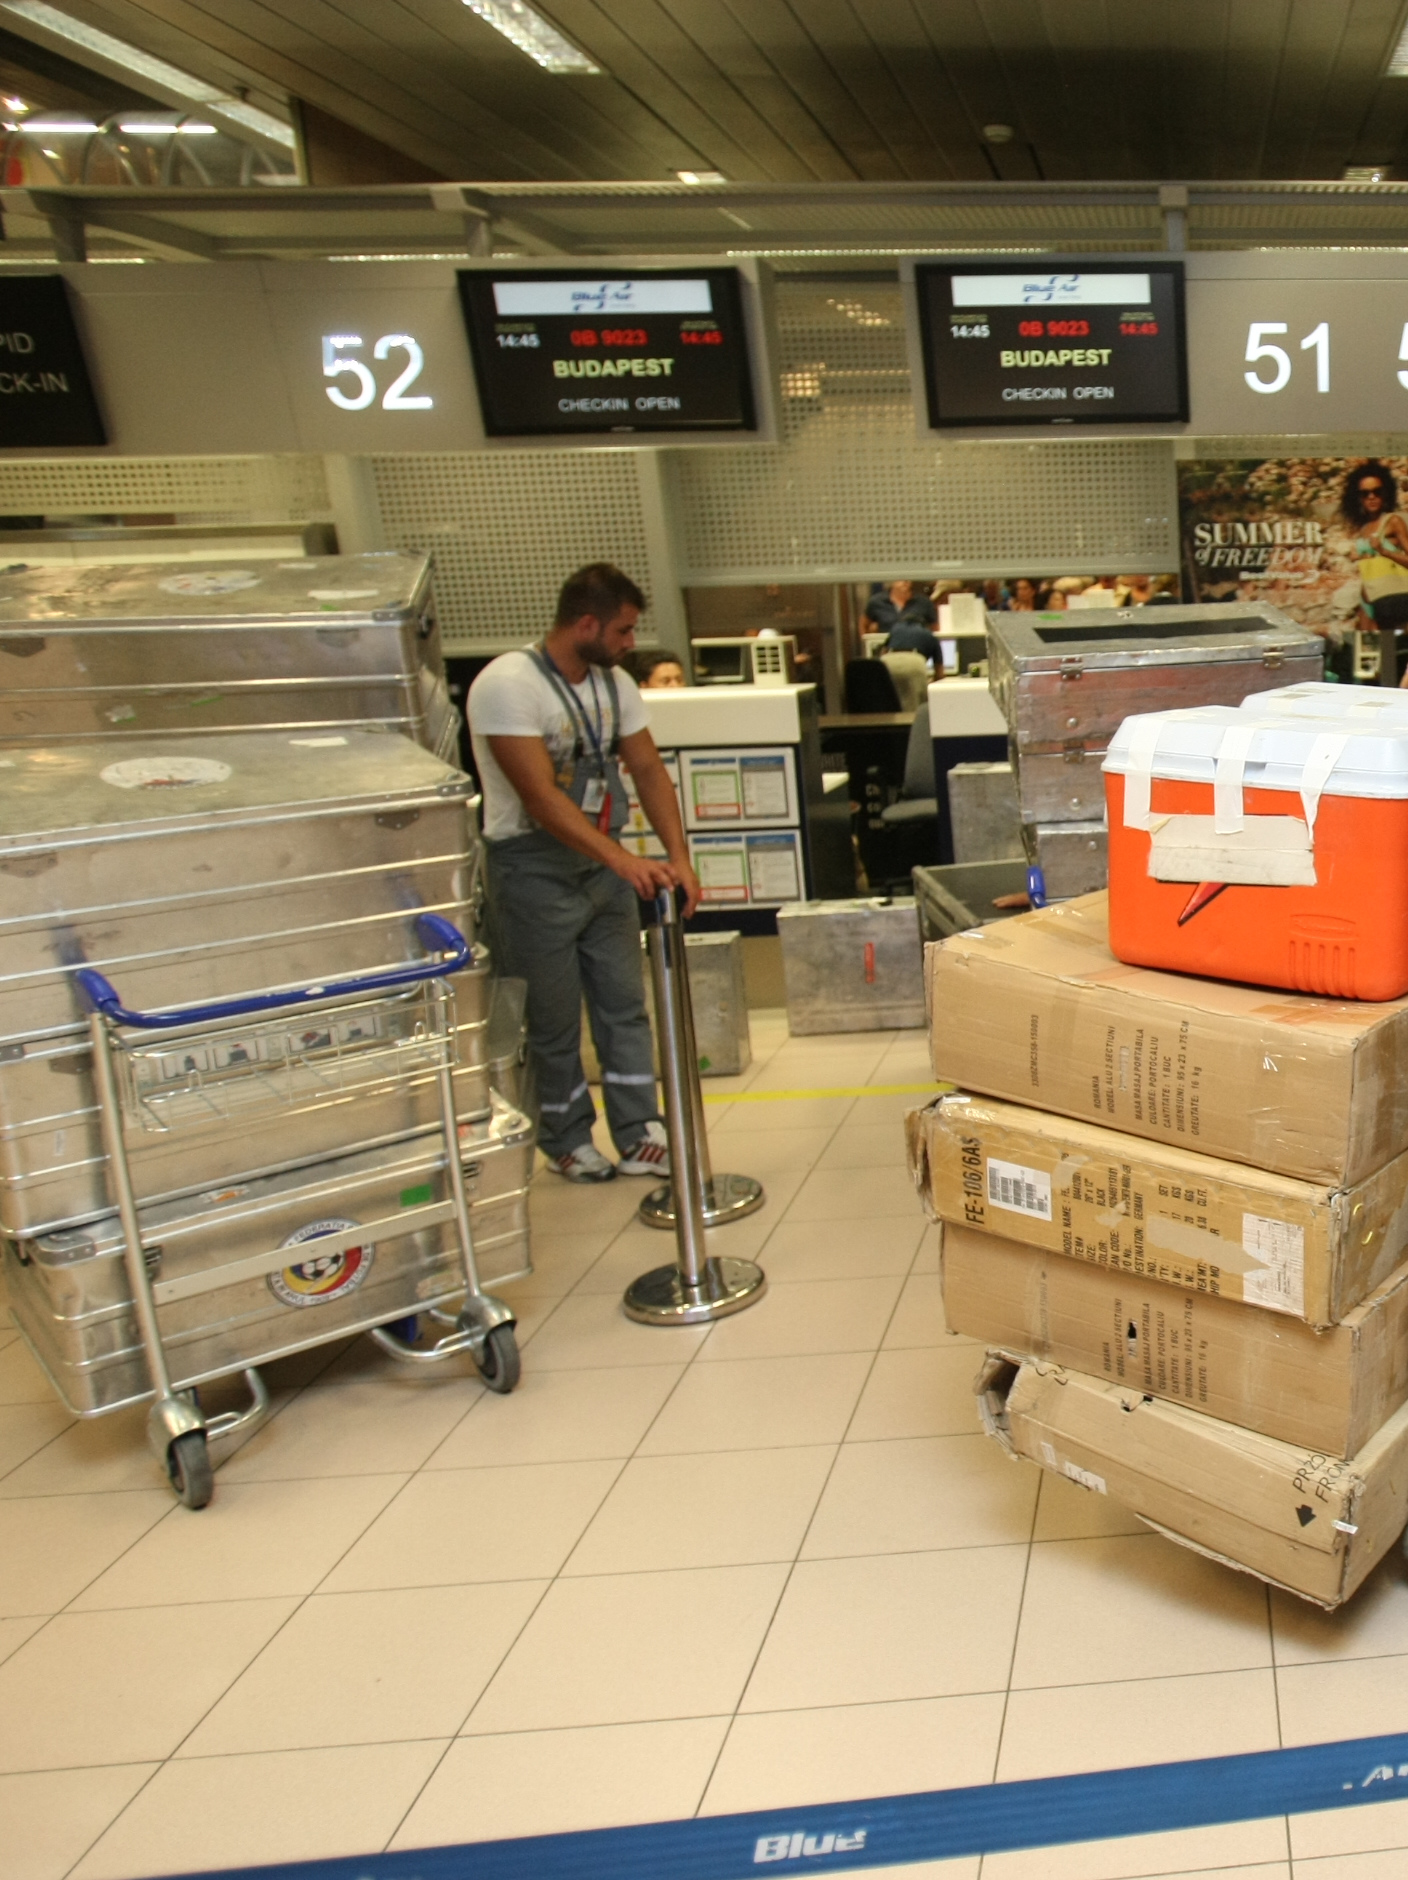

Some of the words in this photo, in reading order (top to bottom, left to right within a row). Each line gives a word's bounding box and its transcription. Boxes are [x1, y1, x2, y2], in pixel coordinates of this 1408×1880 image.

[601, 329, 648, 346] 9023
[951, 325, 990, 338] 14:45
[1047, 320, 1090, 336] 9023
[1119, 323, 1158, 336] 14:45
[496, 334, 540, 348] 14:45
[680, 331, 723, 345] 14:45
[1001, 349, 1112, 368] BUDAPEST
[1244, 322, 1330, 394] 51
[322, 333, 433, 411] 52
[553, 358, 674, 378] BUDAPEST
[1002, 387, 1067, 401] CHECKIN
[1073, 386, 1115, 400] OPEN
[558, 398, 629, 412] CHECKIN
[635, 396, 680, 411] OPEN
[1194, 522, 1323, 546] SUMMER
[1211, 547, 1324, 568] FREEDOM
[1180, 1020, 1190, 1033] CM
[1105, 1026, 1115, 1063] SECTIUNI
[1179, 1034, 1188, 1044] 75
[1134, 1029, 1144, 1072] PORTABILA
[1177, 1054, 1186, 1064] 23
[1149, 1036, 1159, 1088] PORTOCALIU
[1163, 1056, 1171, 1073] BUC
[1192, 1066, 1202, 1077] kg
[1105, 1070, 1114, 1085] ALU
[1133, 1074, 1143, 1099] MASAJ
[1092, 1075, 1101, 1109] ROMANIA
[1106, 1086, 1115, 1114] MODEL:
[1134, 1100, 1144, 1120] MASA
[1148, 1089, 1158, 1125] CULOARE:
[1191, 1095, 1201, 1136] GREUTATE:
[1096, 1188, 1106, 1207] BLACK
[1158, 1185, 1168, 1196] SET
[1171, 1187, 1181, 1199] KGS
[1184, 1189, 1194, 1202] KGS
[1133, 1192, 1143, 1220] GERMANY
[1062, 1206, 1072, 1228] NAME
[1184, 1298, 1193, 1310] CM
[1114, 1298, 1122, 1332] SECTIUNI
[1142, 1303, 1150, 1342] PORTABILA
[1156, 1311, 1165, 1356] PORTOCALIU
[1170, 1329, 1178, 1344] BUC
[1103, 1342, 1111, 1372] ROMANIA
[1143, 1343, 1151, 1366] MASAJ
[1144, 1367, 1153, 1385] MASA
[753, 1831, 867, 1863] Blue
